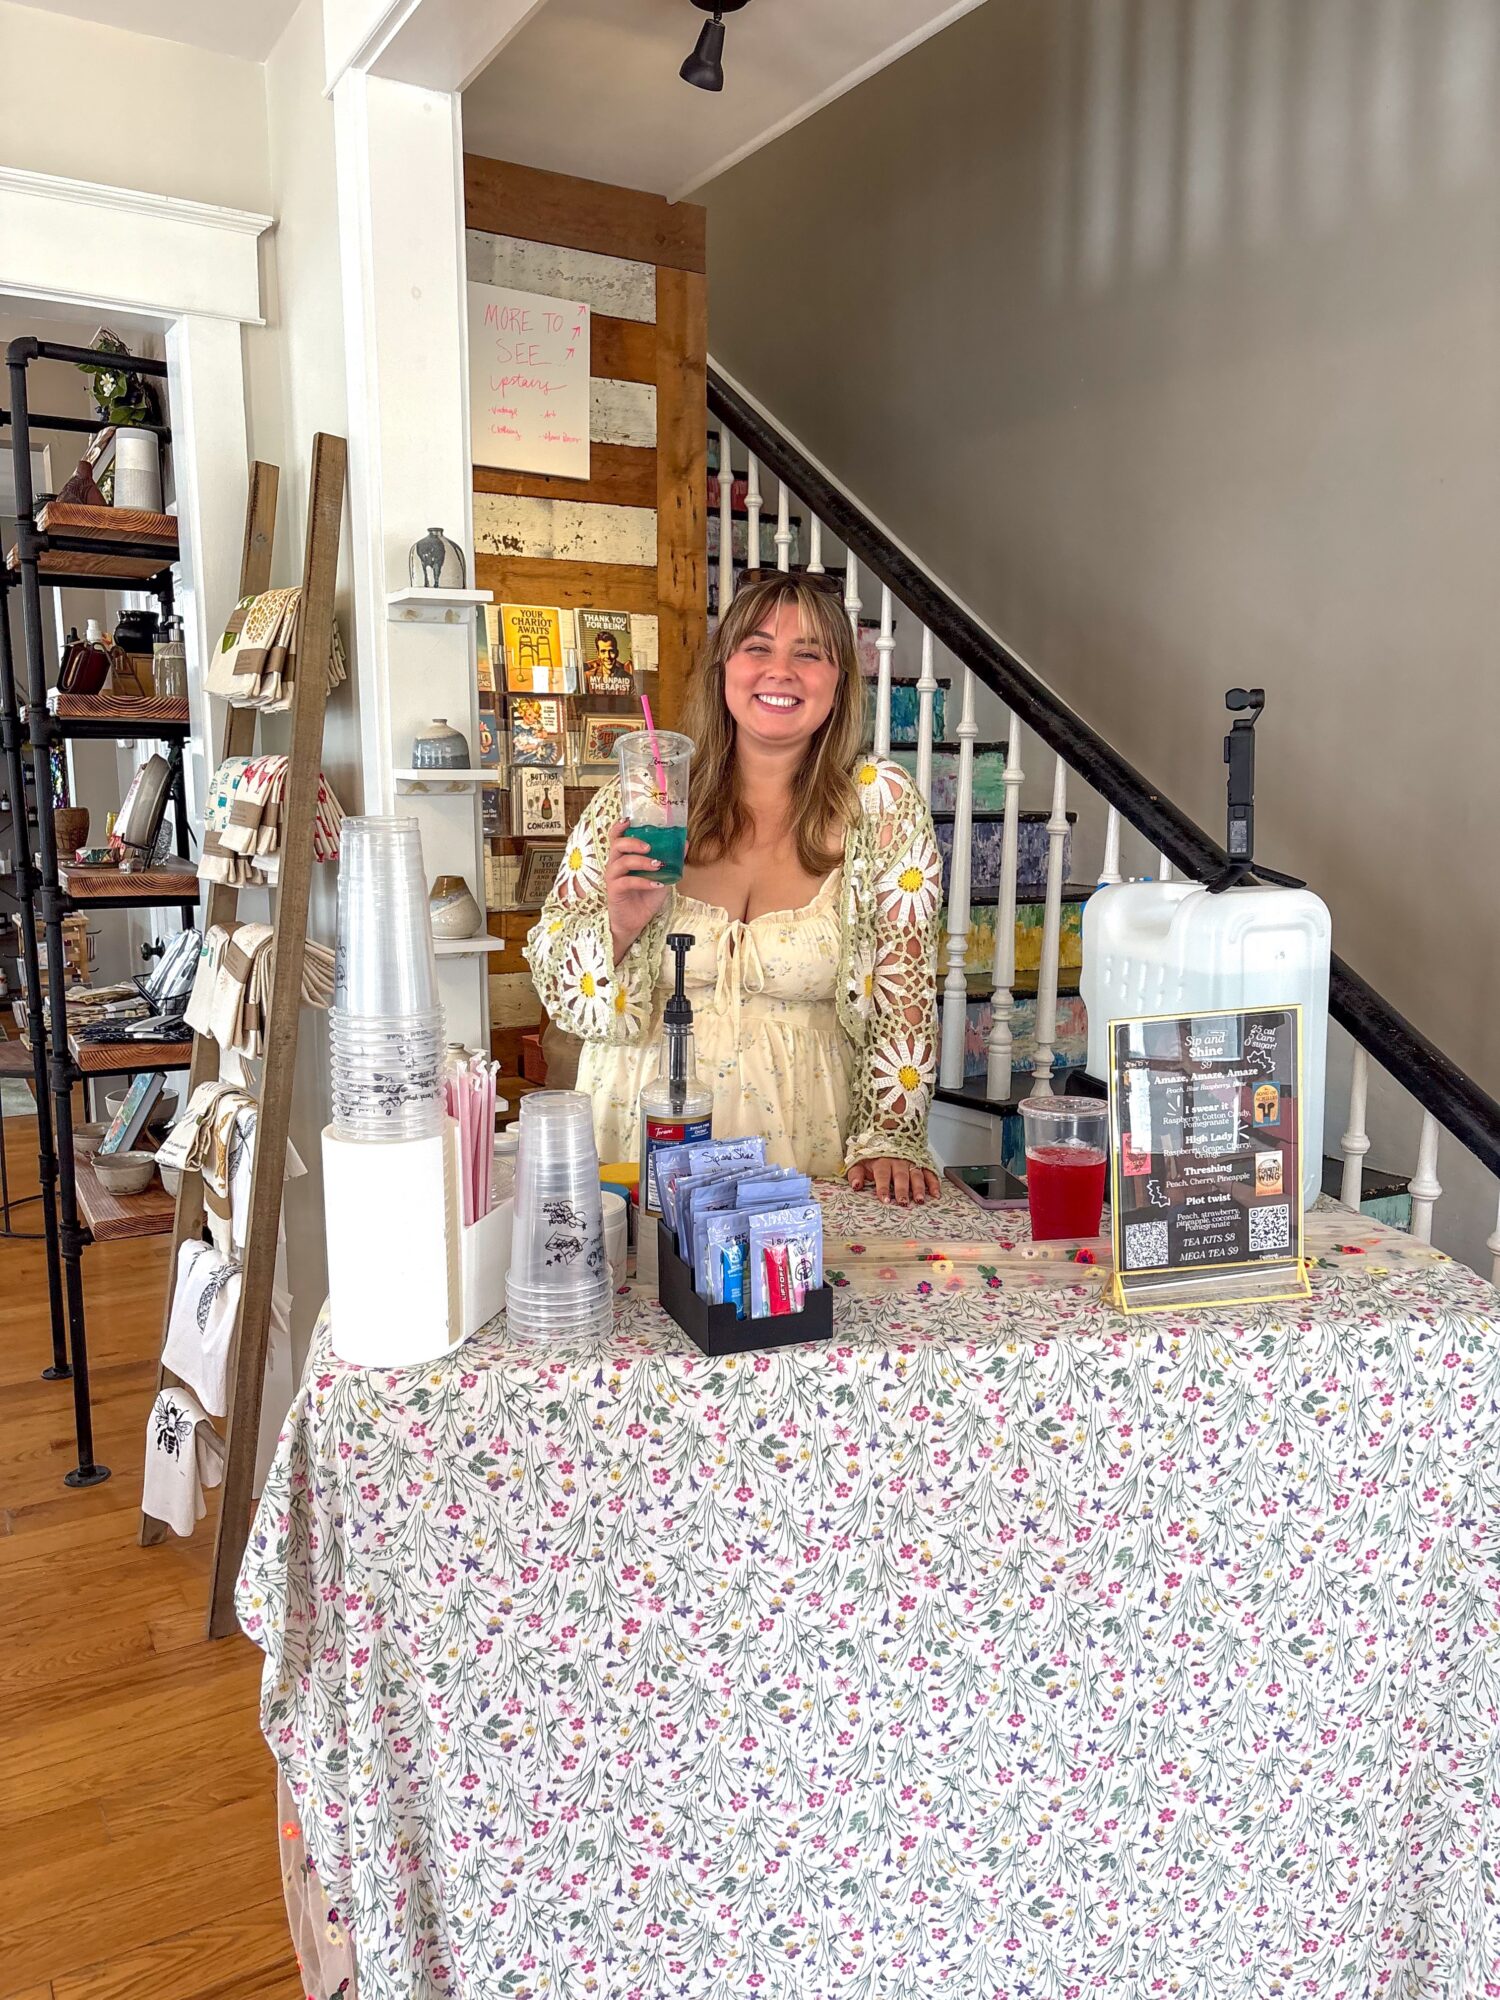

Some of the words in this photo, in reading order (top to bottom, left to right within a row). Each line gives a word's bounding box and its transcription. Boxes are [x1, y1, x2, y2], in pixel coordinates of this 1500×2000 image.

[484, 304, 533, 335] MORE
[542, 313, 564, 333] TO
[496, 338, 552, 366] SEE
[520, 609, 544, 618] YOUR
[511, 617, 553, 628] CHARIOT
[583, 614, 610, 623] THANK
[611, 616, 627, 625] YOU
[517, 626, 550, 635] AWAITS
[603, 623, 626, 631] BEING
[590, 676, 602, 684] MY
[602, 677, 631, 685] UNPAID
[591, 683, 631, 691] THERAPIST
[527, 821, 561, 830] CONGRATS
[1263, 1027, 1276, 1036] cal
[1184, 1035, 1202, 1047] Sip
[1204, 1031, 1226, 1045] and
[1252, 1040, 1278, 1051] sugar!
[1189, 1046, 1224, 1058] Shine
[1154, 1075, 1189, 1085] Amaze,
[1190, 1070, 1225, 1081] Amaze,
[1226, 1067, 1259, 1078] Amaze
[1185, 1106, 1190, 1114] I
[1191, 1103, 1220, 1114] swear
[1221, 1102, 1229, 1110] it
[1202, 1112, 1226, 1120] Cotton
[1227, 1109, 1252, 1118] Cndy,
[1183, 1118, 1230, 1128] Pomegranate
[1185, 1134, 1208, 1145] High
[1210, 1132, 1233, 1142] Lady
[702, 1151, 721, 1167] Sip
[720, 1152, 732, 1161] and
[733, 1147, 755, 1161] Shine
[1184, 1163, 1232, 1176] Threshing
[1166, 1180, 1189, 1189] Peach,
[1189, 1178, 1216, 1187] Cherry,
[1217, 1172, 1251, 1183] Pineapple
[1258, 1172, 1281, 1182] WING
[1186, 1196, 1206, 1206] Plot
[1207, 1193, 1232, 1203] twist
[1185, 1221, 1231, 1232] Pomegranate
[1183, 1237, 1200, 1247] TEA
[1202, 1234, 1223, 1247] KITS
[1224, 1233, 1236, 1243] $8
[1179, 1251, 1206, 1262] MEGA
[1208, 1248, 1226, 1258] TEA
[1227, 1246, 1239, 1256] $9
